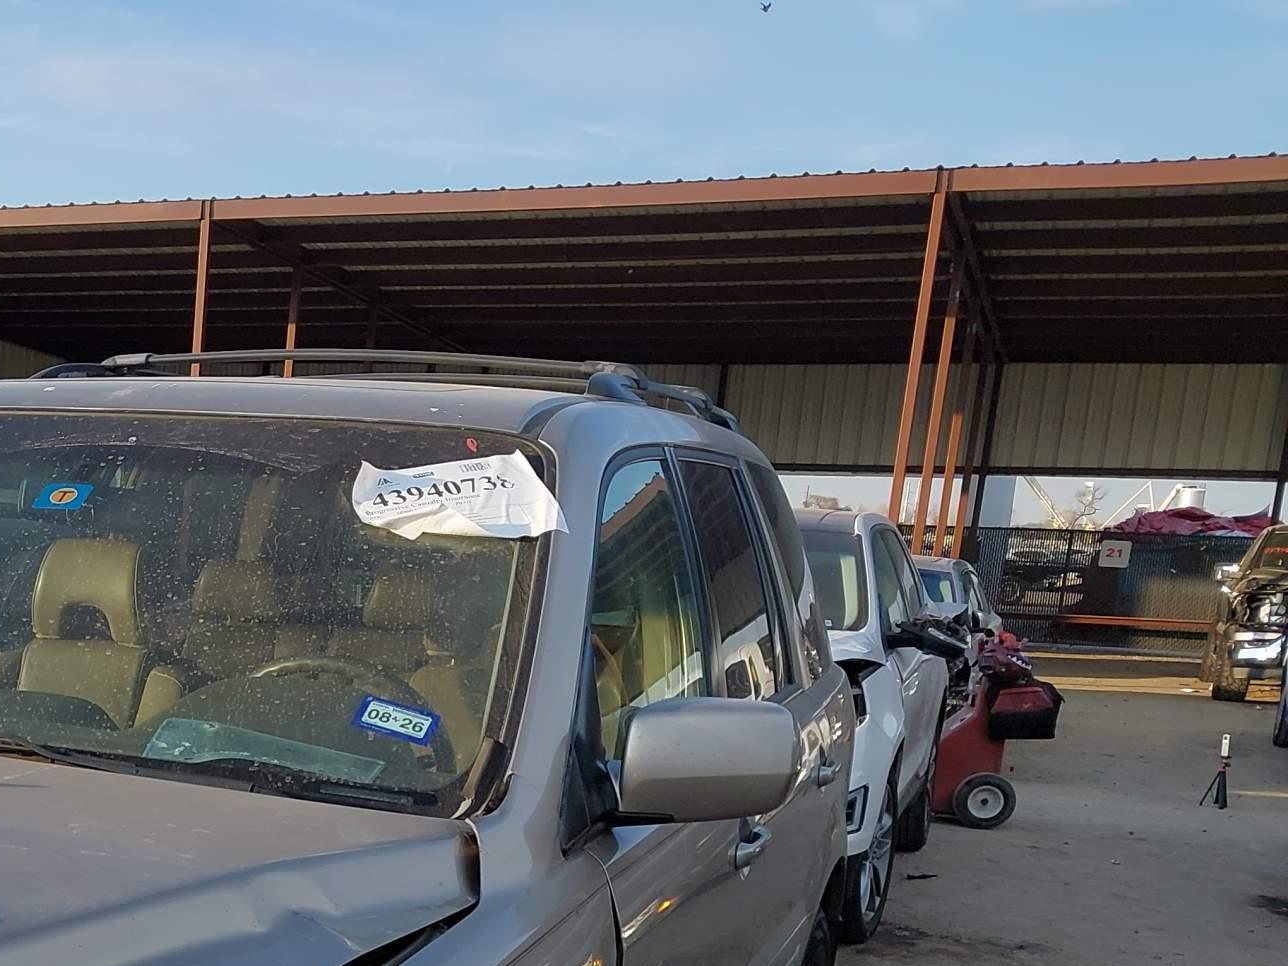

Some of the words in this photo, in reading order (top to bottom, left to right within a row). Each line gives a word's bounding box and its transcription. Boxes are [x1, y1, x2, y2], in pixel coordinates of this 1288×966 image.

[373, 474, 516, 508] 43940738
[1105, 547, 1123, 558] 21
[367, 708, 392, 723] 08
[399, 717, 425, 733] 26
